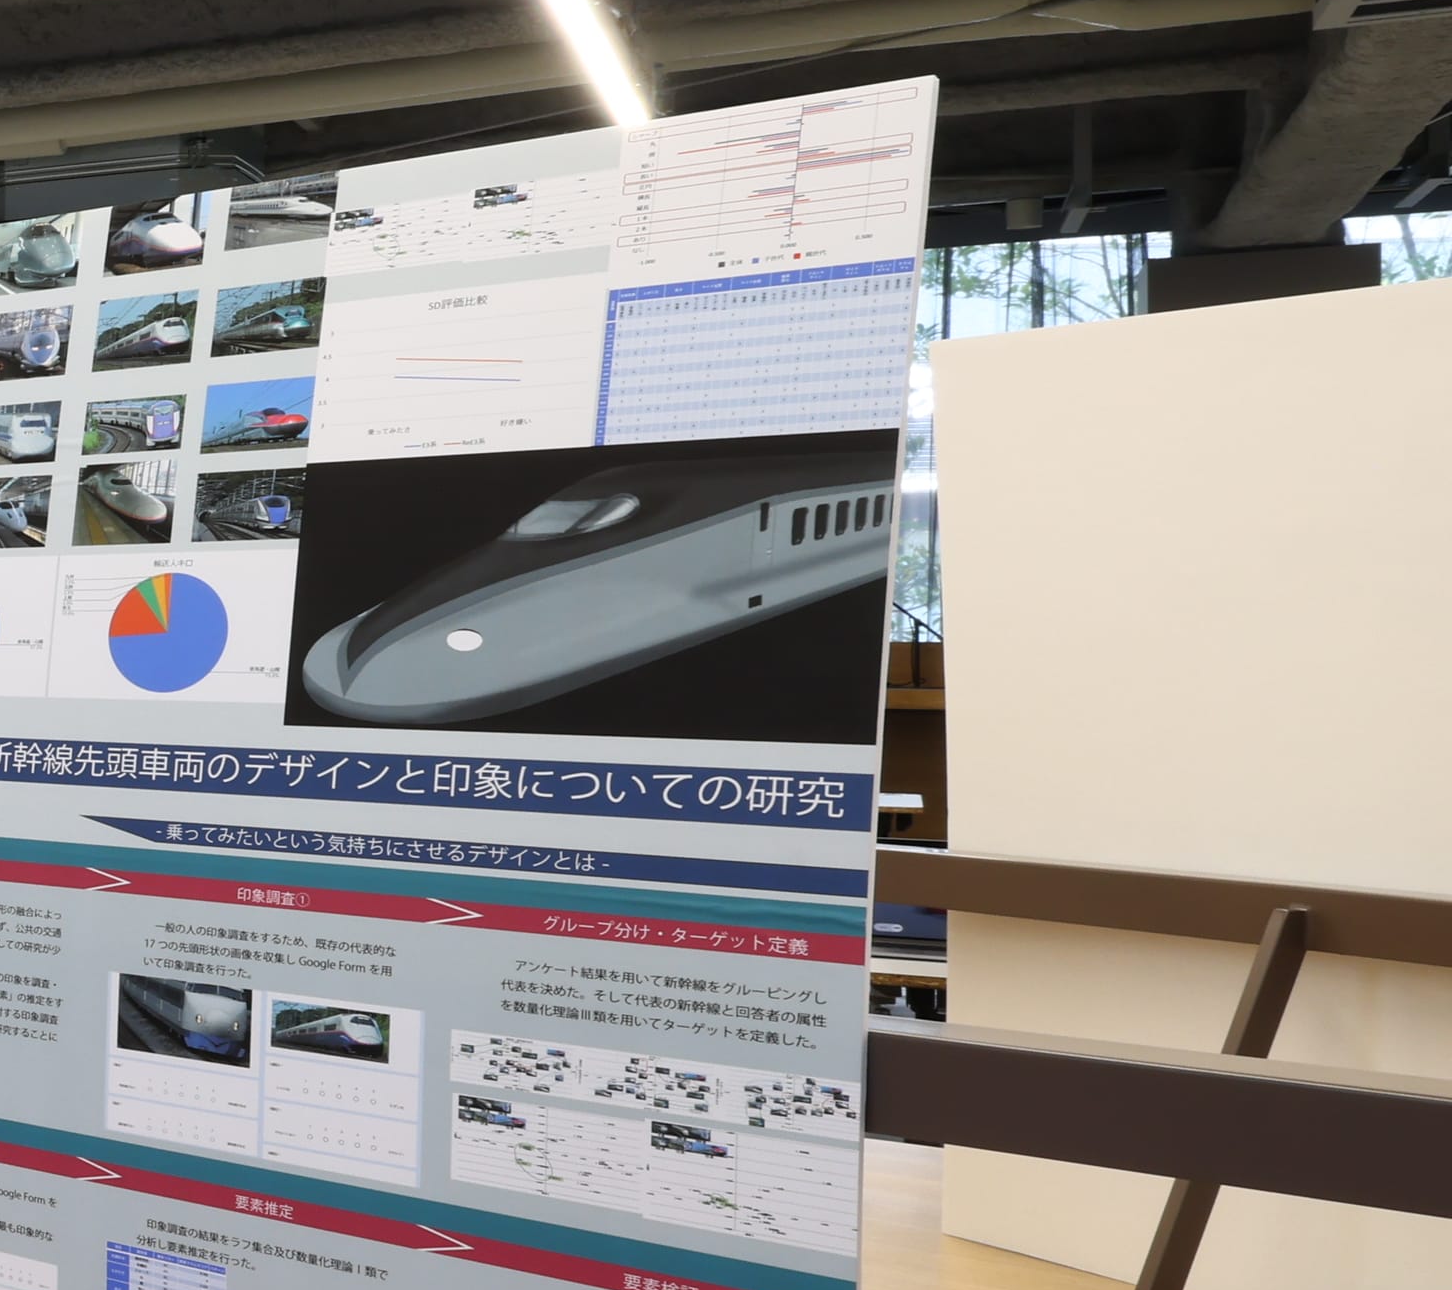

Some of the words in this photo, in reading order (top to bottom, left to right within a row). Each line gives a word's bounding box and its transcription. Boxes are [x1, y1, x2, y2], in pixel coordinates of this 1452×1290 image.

[166, 823, 595, 873] 乗ってみたいという気持ちにさせるデザインとは
[236, 887, 310, 908] 印象調査①
[155, 922, 397, 958] 一般の人の印象調査をするため、既存の代表的な
[543, 915, 810, 956] グループ分け・ターゲット定義
[143, 955, 253, 981] いて印象調査を行った。
[298, 954, 336, 972] Google
[338, 958, 366, 974] Form
[515, 959, 828, 1006] アンケート結果を用いて新幹線をグルーピングし
[500, 978, 828, 1030] 代表を決めた。そして代表の新幹線と回答者の属性
[22, 1189, 46, 1207] Form
[235, 1193, 294, 1220] 要素推定
[135, 1234, 257, 1272] 分析し要素推定を行った。
